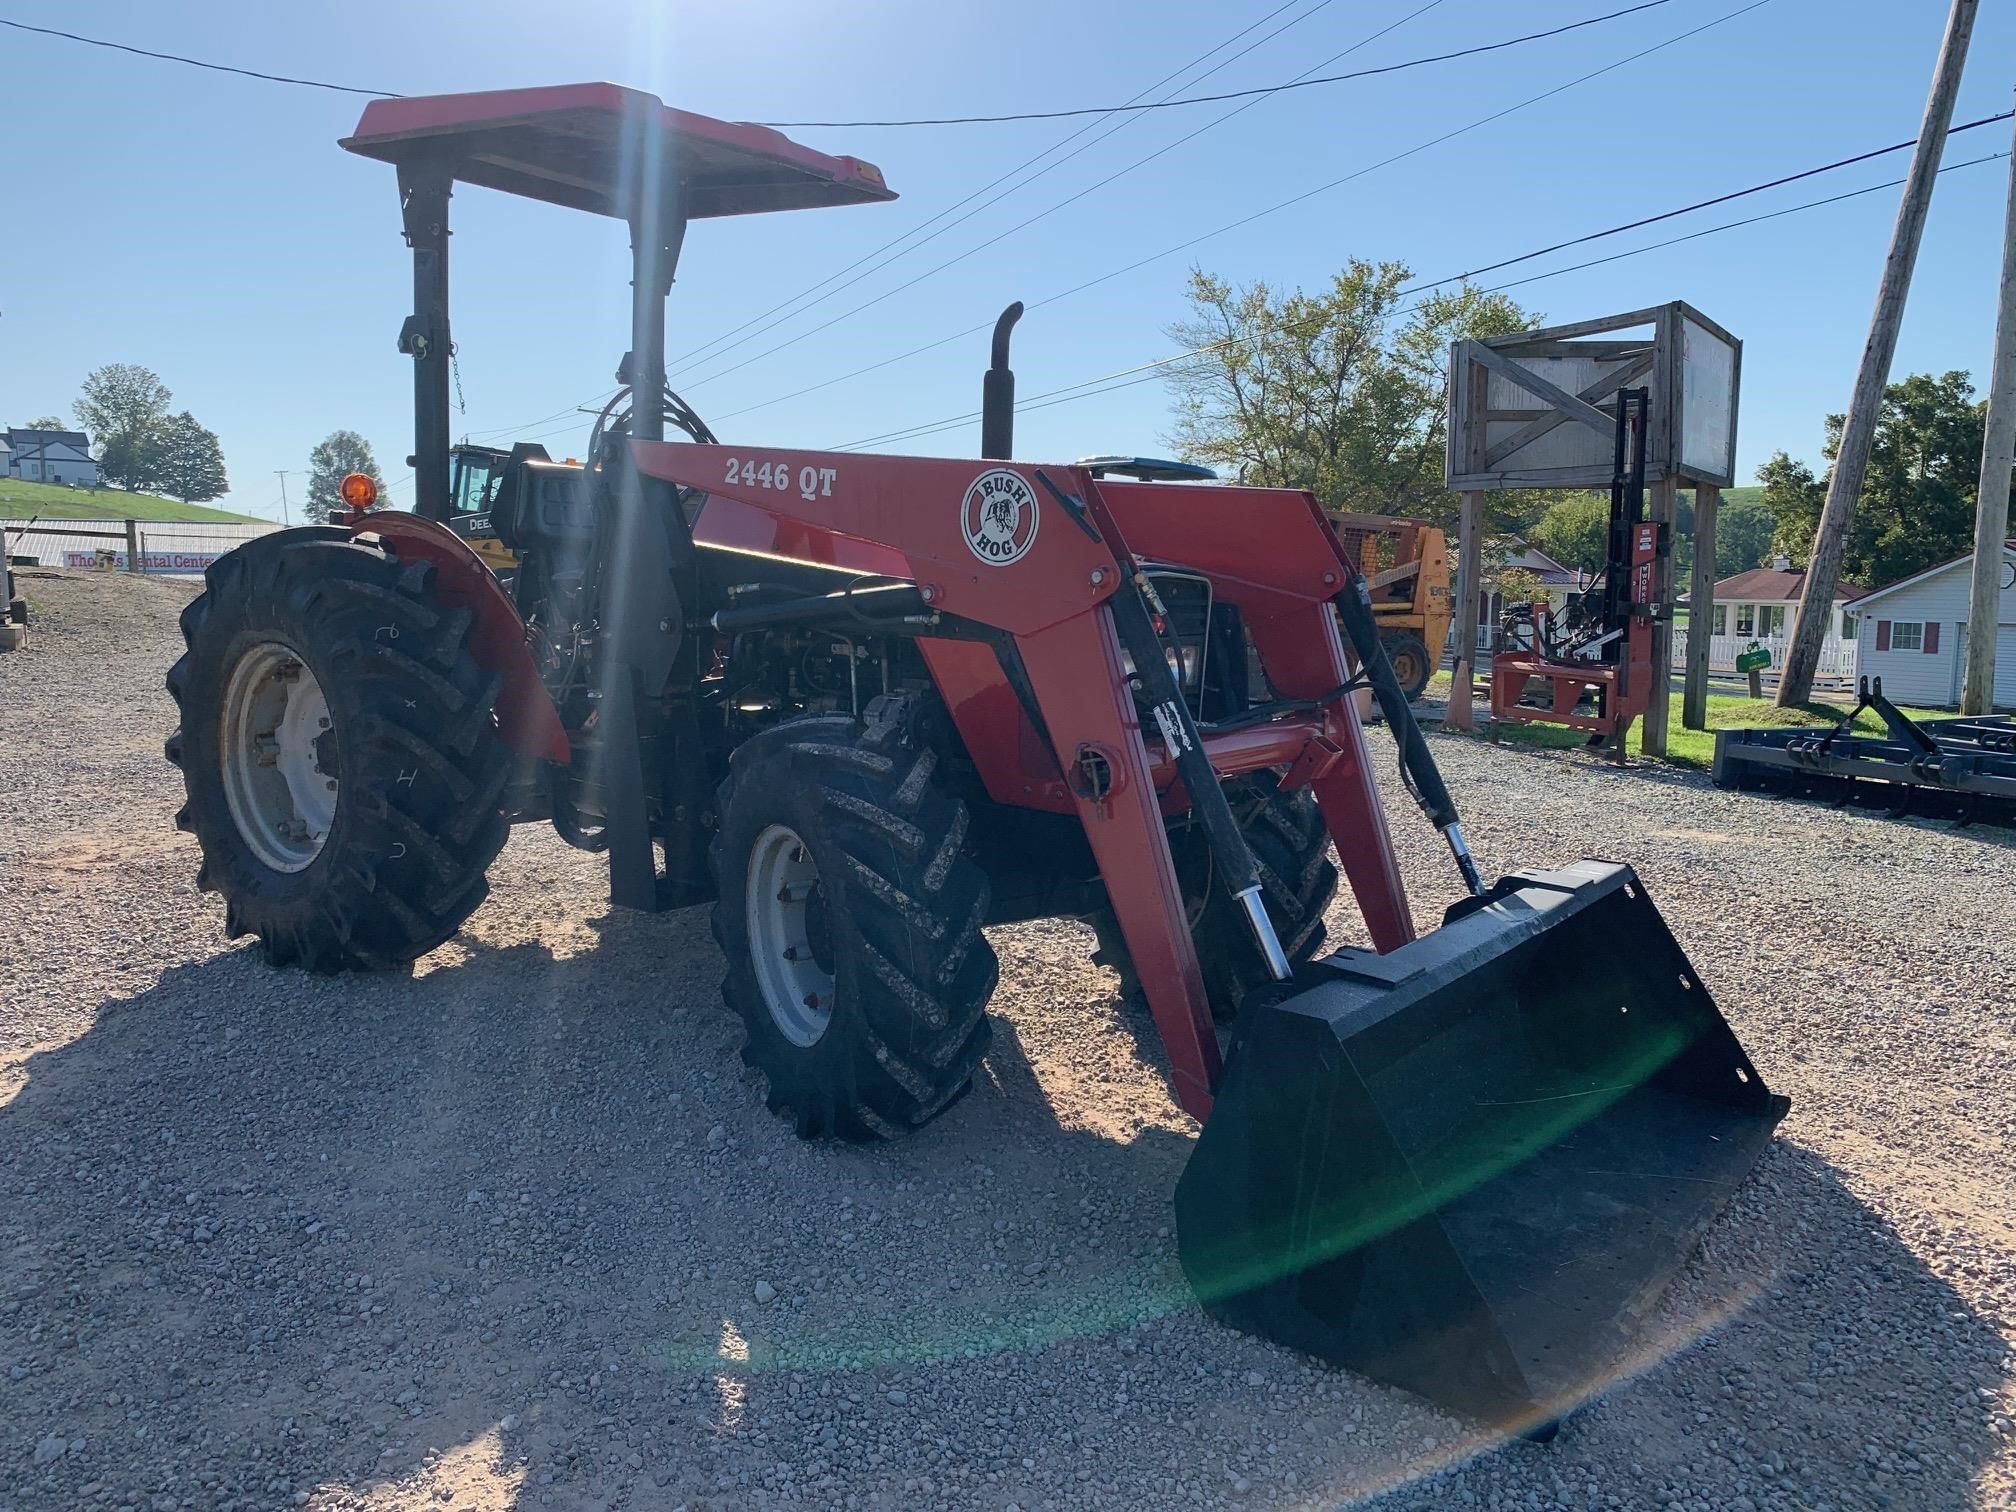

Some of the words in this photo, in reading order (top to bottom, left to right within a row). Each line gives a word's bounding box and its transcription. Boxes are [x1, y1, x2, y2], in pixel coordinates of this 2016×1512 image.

[725, 457, 790, 491] 2446
[799, 466, 837, 501] QT
[981, 477, 1026, 504] BUSH
[470, 518, 492, 530] DEE
[976, 533, 1012, 556] HOG
[69, 553, 124, 568] Thos
[126, 553, 172, 568] ental
